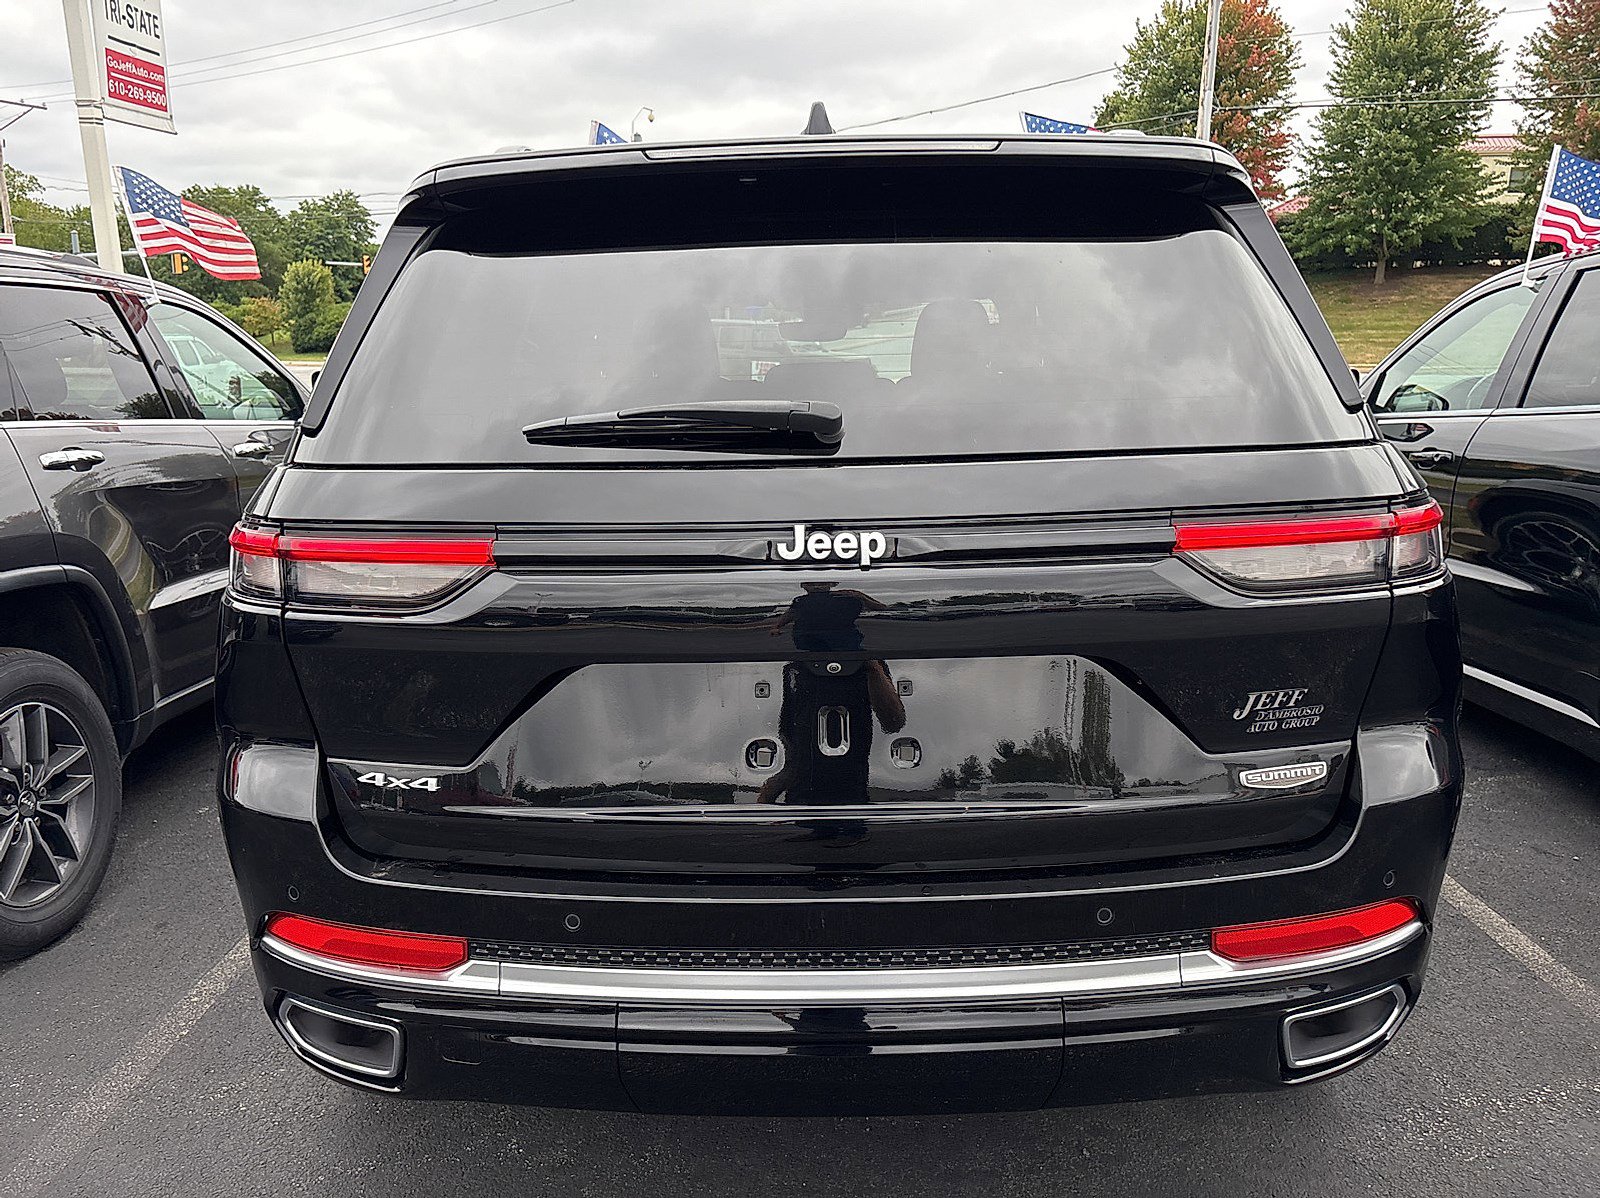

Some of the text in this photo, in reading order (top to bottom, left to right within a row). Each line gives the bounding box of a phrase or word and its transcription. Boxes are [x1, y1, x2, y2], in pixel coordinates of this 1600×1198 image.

[104, 0, 160, 39] TRI-STATE
[107, 56, 165, 83] GoJeffAuto.com
[108, 79, 167, 107] 610-269-9500
[777, 524, 887, 568] Jeep
[1233, 688, 1309, 720] JEFF
[1246, 715, 1320, 733] AUTO GROUP
[356, 771, 442, 792] 4x4
[1247, 765, 1323, 783] SUMMIT
